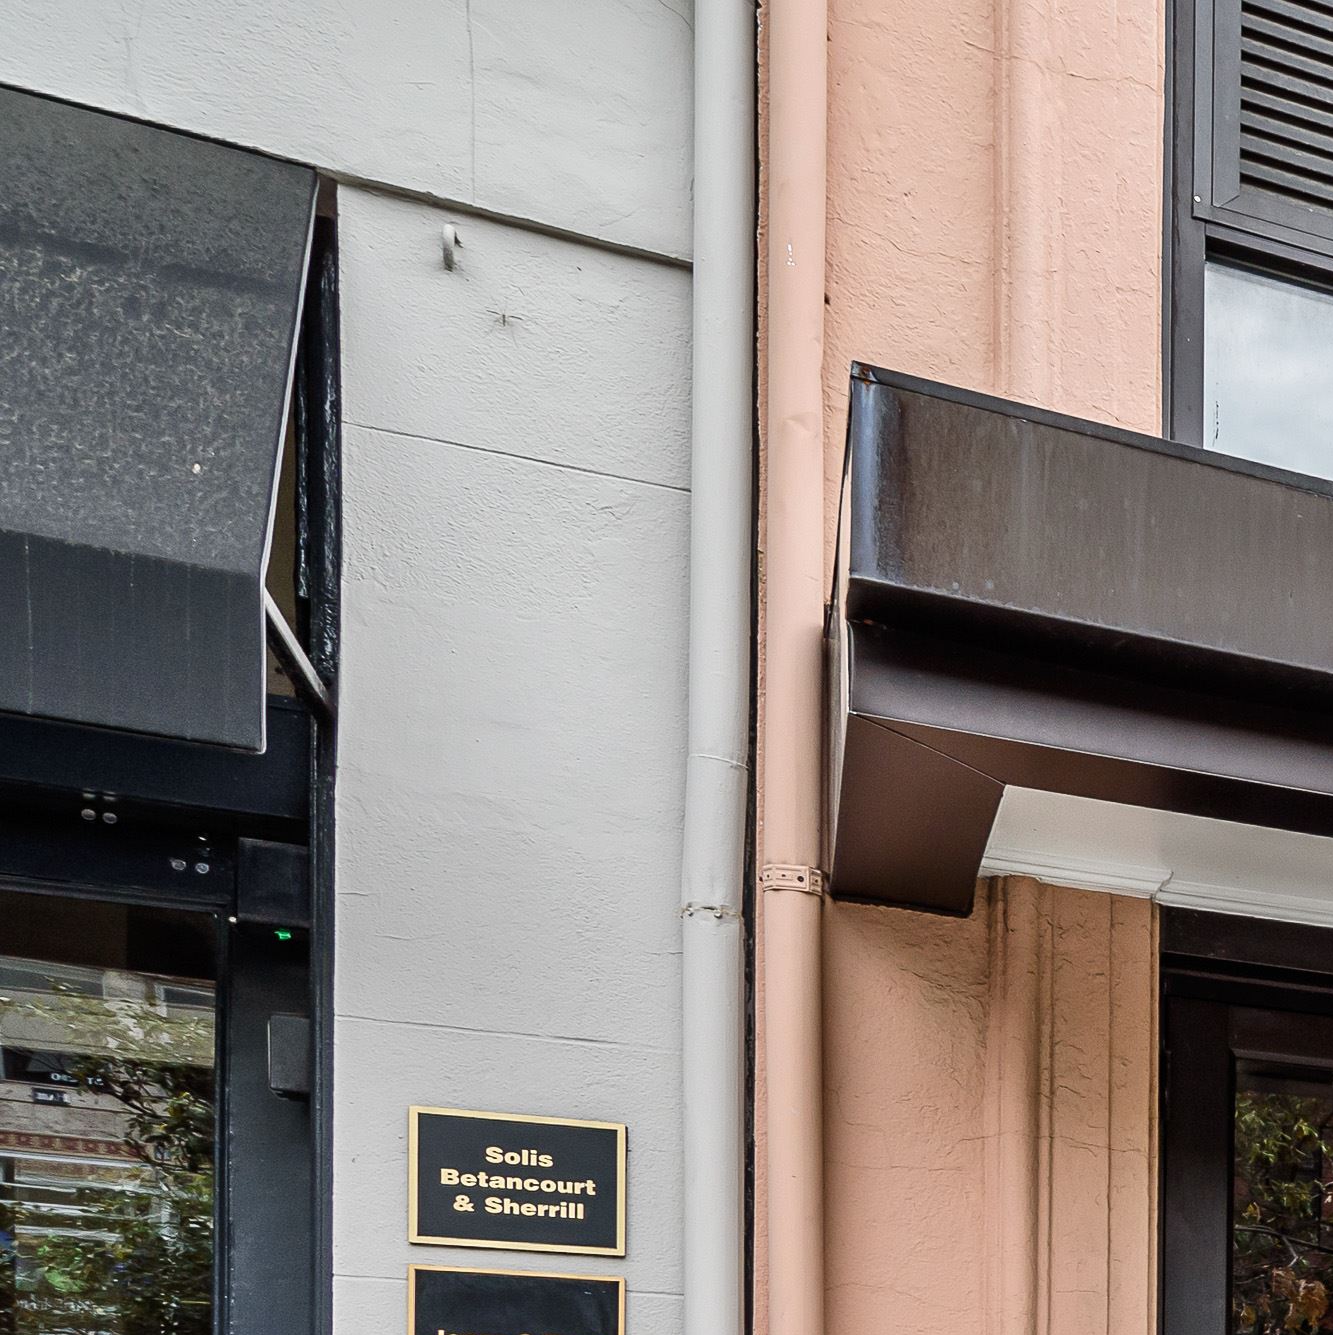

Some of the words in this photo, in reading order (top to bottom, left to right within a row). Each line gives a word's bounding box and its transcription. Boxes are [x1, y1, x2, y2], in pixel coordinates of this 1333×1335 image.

[485, 1146, 554, 1168] Solis
[440, 1168, 596, 1196] Betancourt
[452, 1195, 475, 1213] &
[484, 1196, 585, 1220] Sherrill
